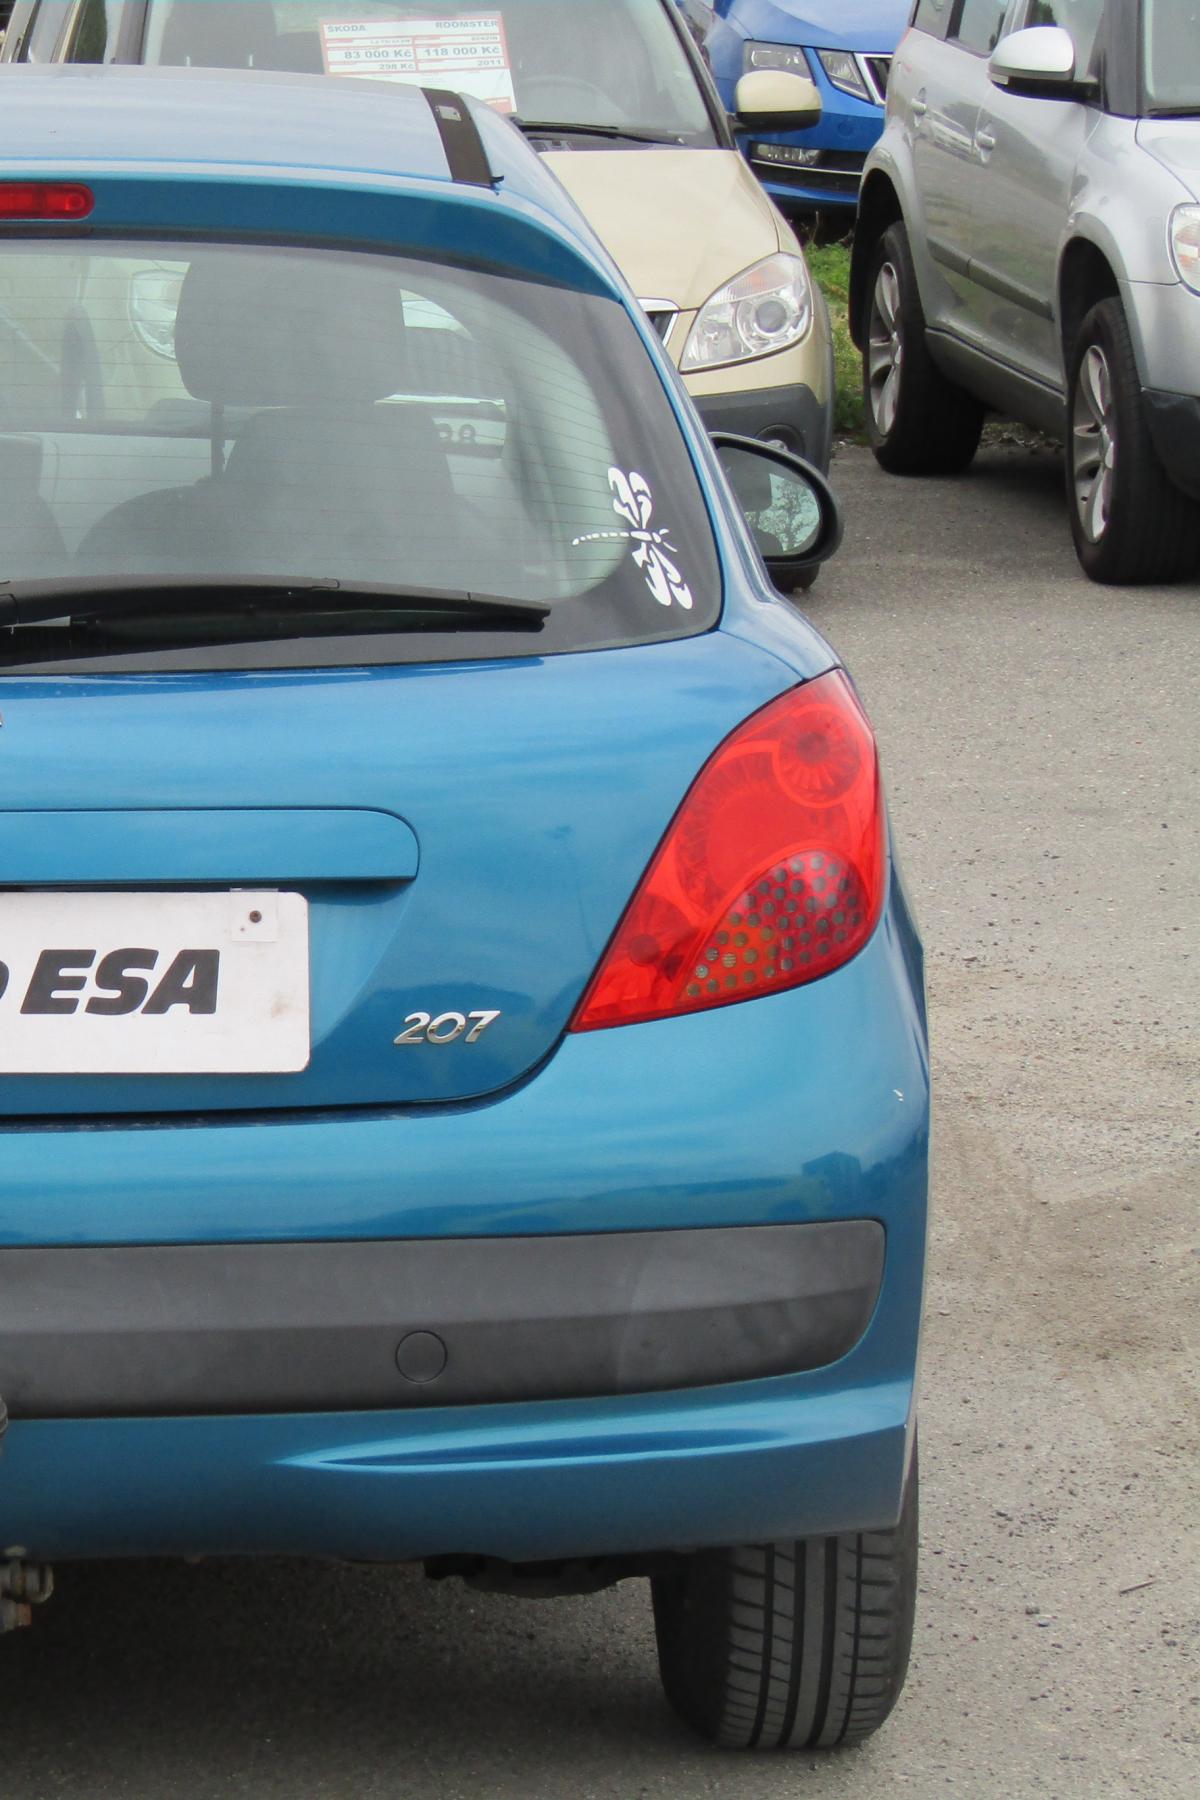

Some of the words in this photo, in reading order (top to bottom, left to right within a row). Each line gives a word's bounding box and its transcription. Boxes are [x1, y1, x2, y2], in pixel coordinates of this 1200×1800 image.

[435, 21, 498, 29] ROOMSTER
[344, 50, 361, 59] 83
[365, 49, 389, 58] 000
[424, 47, 449, 57] 118
[453, 46, 478, 55] 000
[20, 948, 220, 1017] ESA
[393, 1010, 501, 1045] 207
